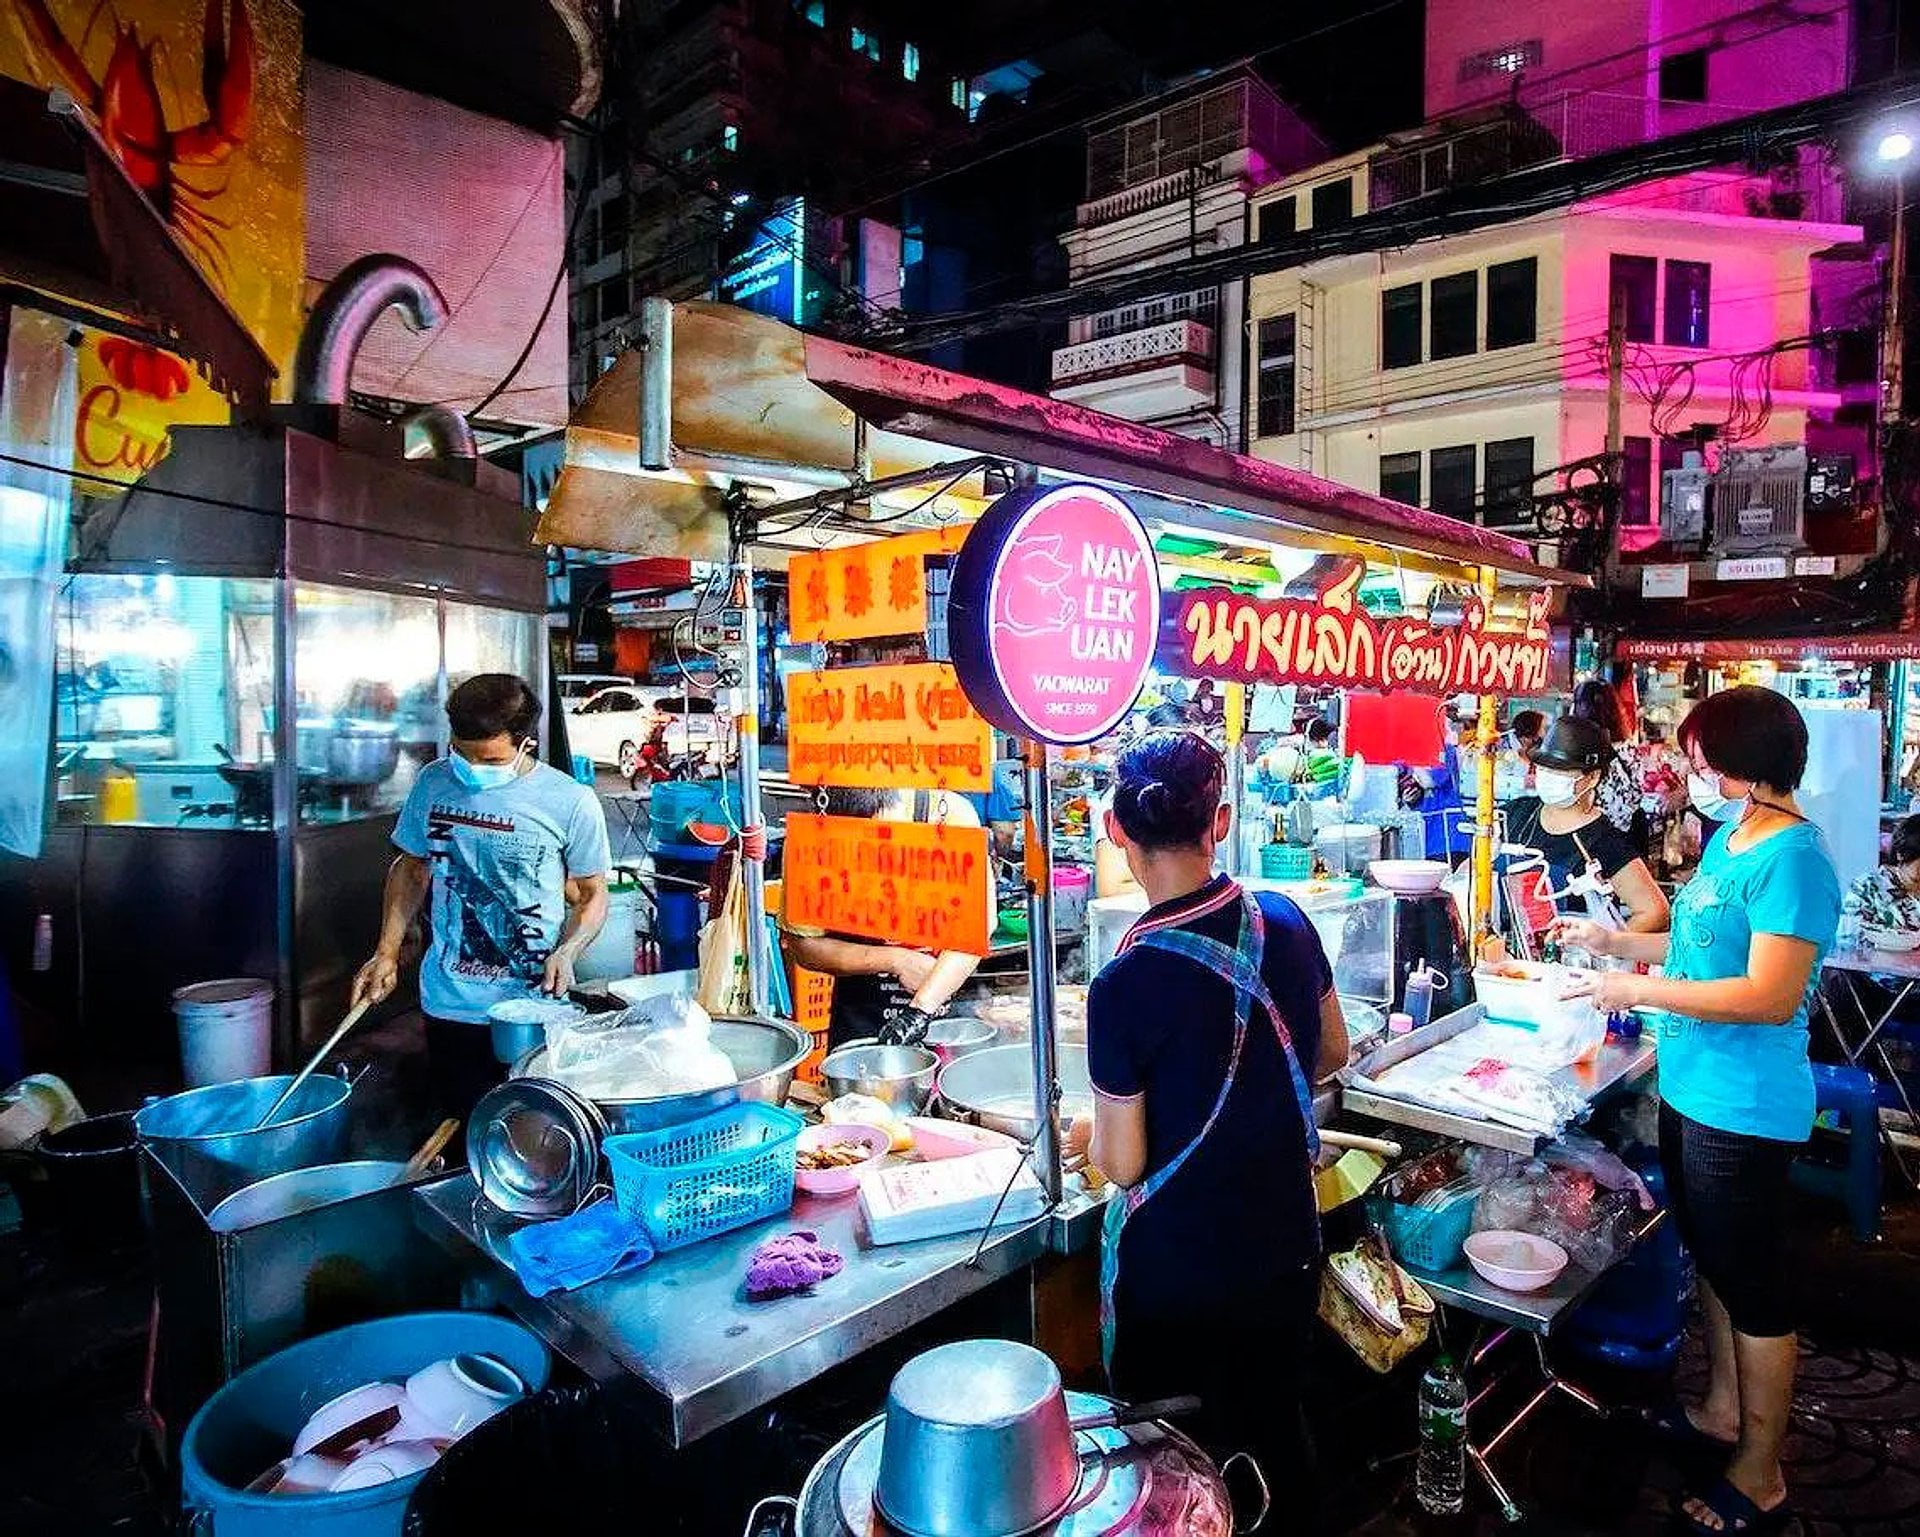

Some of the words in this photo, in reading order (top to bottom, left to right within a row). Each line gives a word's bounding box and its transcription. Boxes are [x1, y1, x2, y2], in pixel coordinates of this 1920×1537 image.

[1080, 541, 1142, 583] NAY
[1084, 584, 1137, 622] LEK
[1070, 624, 1134, 662] UAN
[1032, 675, 1110, 694] YAOWARAT
[1043, 702, 1074, 716] SINCE
